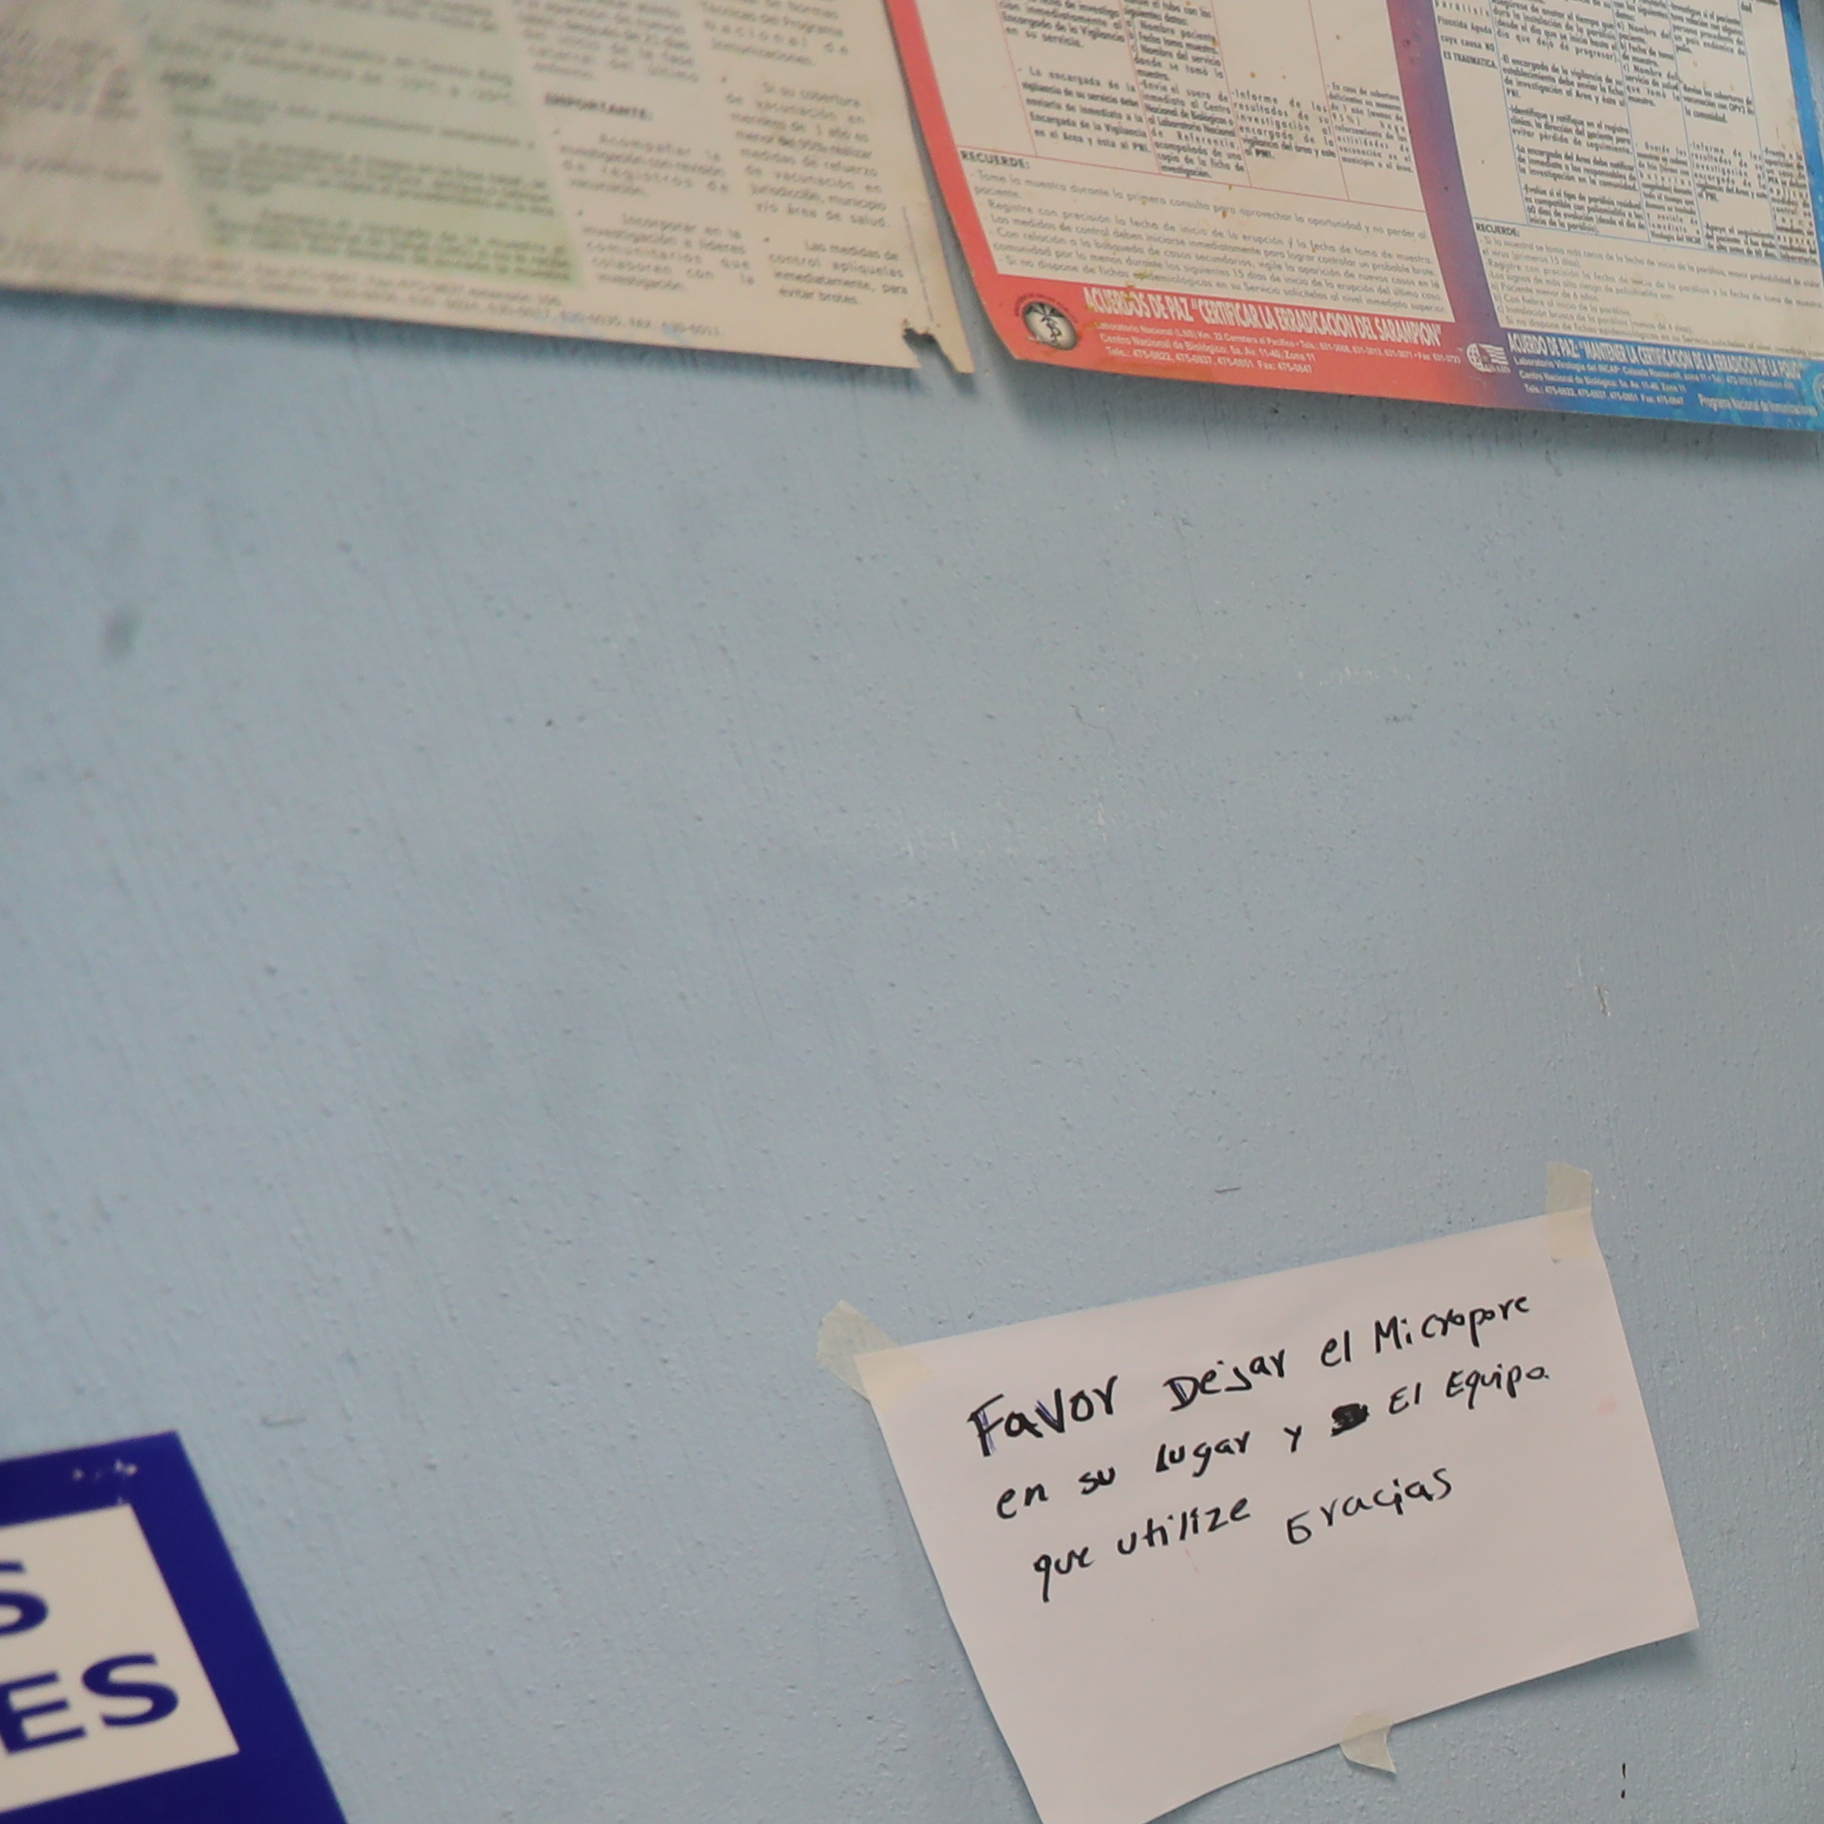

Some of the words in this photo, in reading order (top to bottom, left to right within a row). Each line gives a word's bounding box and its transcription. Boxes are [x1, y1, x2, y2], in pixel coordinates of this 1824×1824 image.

[960, 150, 1031, 169] RECUERDE:
[1083, 287, 1148, 317] ACUERDOS
[1150, 297, 1167, 318] DE
[1167, 300, 1193, 322] PAZ
[1259, 308, 1276, 330] LA
[1277, 309, 1358, 339] ERRADICACION
[1355, 320, 1375, 340] DEL
[1376, 321, 1442, 347] SARAMPION"
[968, 1374, 1120, 1458] Favor
[1164, 1348, 1288, 1412] Dejar
[1320, 1330, 1353, 1368] el
[1374, 1292, 1531, 1355] Micropore
[995, 1480, 1049, 1521] en
[1079, 1463, 1116, 1496] su
[1032, 1545, 1094, 1602] que
[1116, 1492, 1251, 1558] utilize
